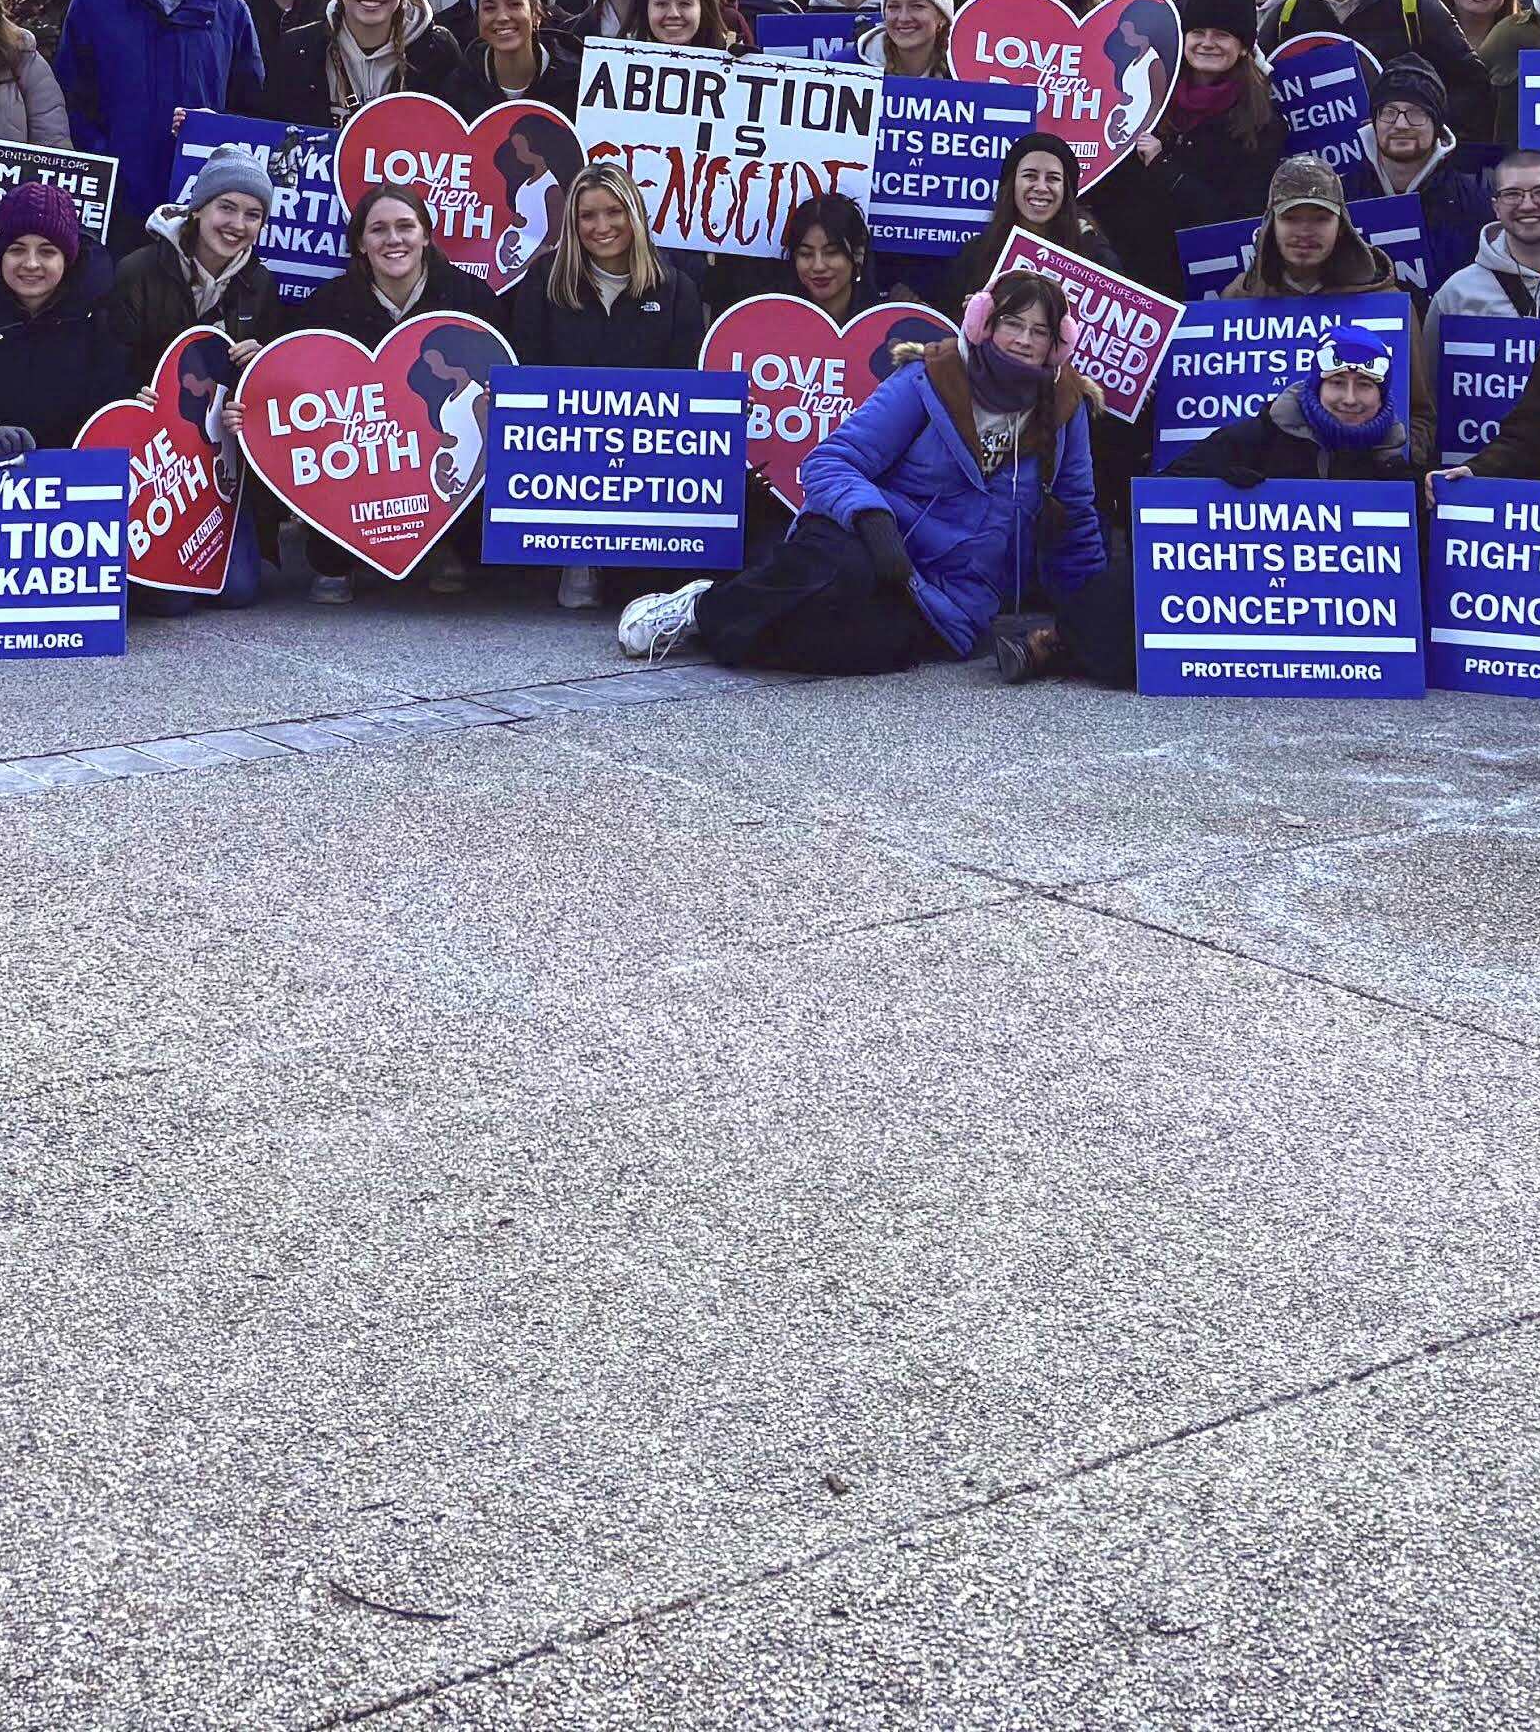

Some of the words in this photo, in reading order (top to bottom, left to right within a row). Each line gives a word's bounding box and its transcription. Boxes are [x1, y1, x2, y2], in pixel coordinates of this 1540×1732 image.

[975, 31, 1082, 77] LOVE
[1020, 63, 1089, 93] them
[581, 61, 874, 136] ABORTION
[696, 122, 767, 158] IS
[363, 147, 473, 189] LOVE
[909, 158, 924, 167] AT
[37, 169, 99, 196] THE
[410, 177, 481, 209] them
[1049, 254, 1153, 310] STUDENTSFORLIFE.ORG
[1172, 349, 1288, 377] RIGHTS
[1272, 376, 1289, 386] AT
[267, 383, 387, 437] LOVE
[558, 389, 679, 418] HUMAN
[781, 381, 856, 415] them
[321, 411, 403, 447] them
[503, 425, 625, 453] RIGHTS
[632, 428, 731, 456] BEGIN
[291, 431, 421, 486] BOTH
[608, 458, 625, 469] AT
[137, 455, 191, 499] them
[508, 473, 723, 505] CONCEPTION
[127, 455, 209, 561] BOTH
[1208, 502, 1342, 532] HUMAN
[522, 534, 704, 553] PROTECTLIFEMI.ORG
[1152, 542, 1285, 572] RIGHTS
[1293, 544, 1401, 573] BEGIN
[1269, 577, 1286, 588] AT
[1161, 595, 1397, 627] CONCEPTION
[1181, 661, 1382, 680] PROTECTLIFEMI.ORG
